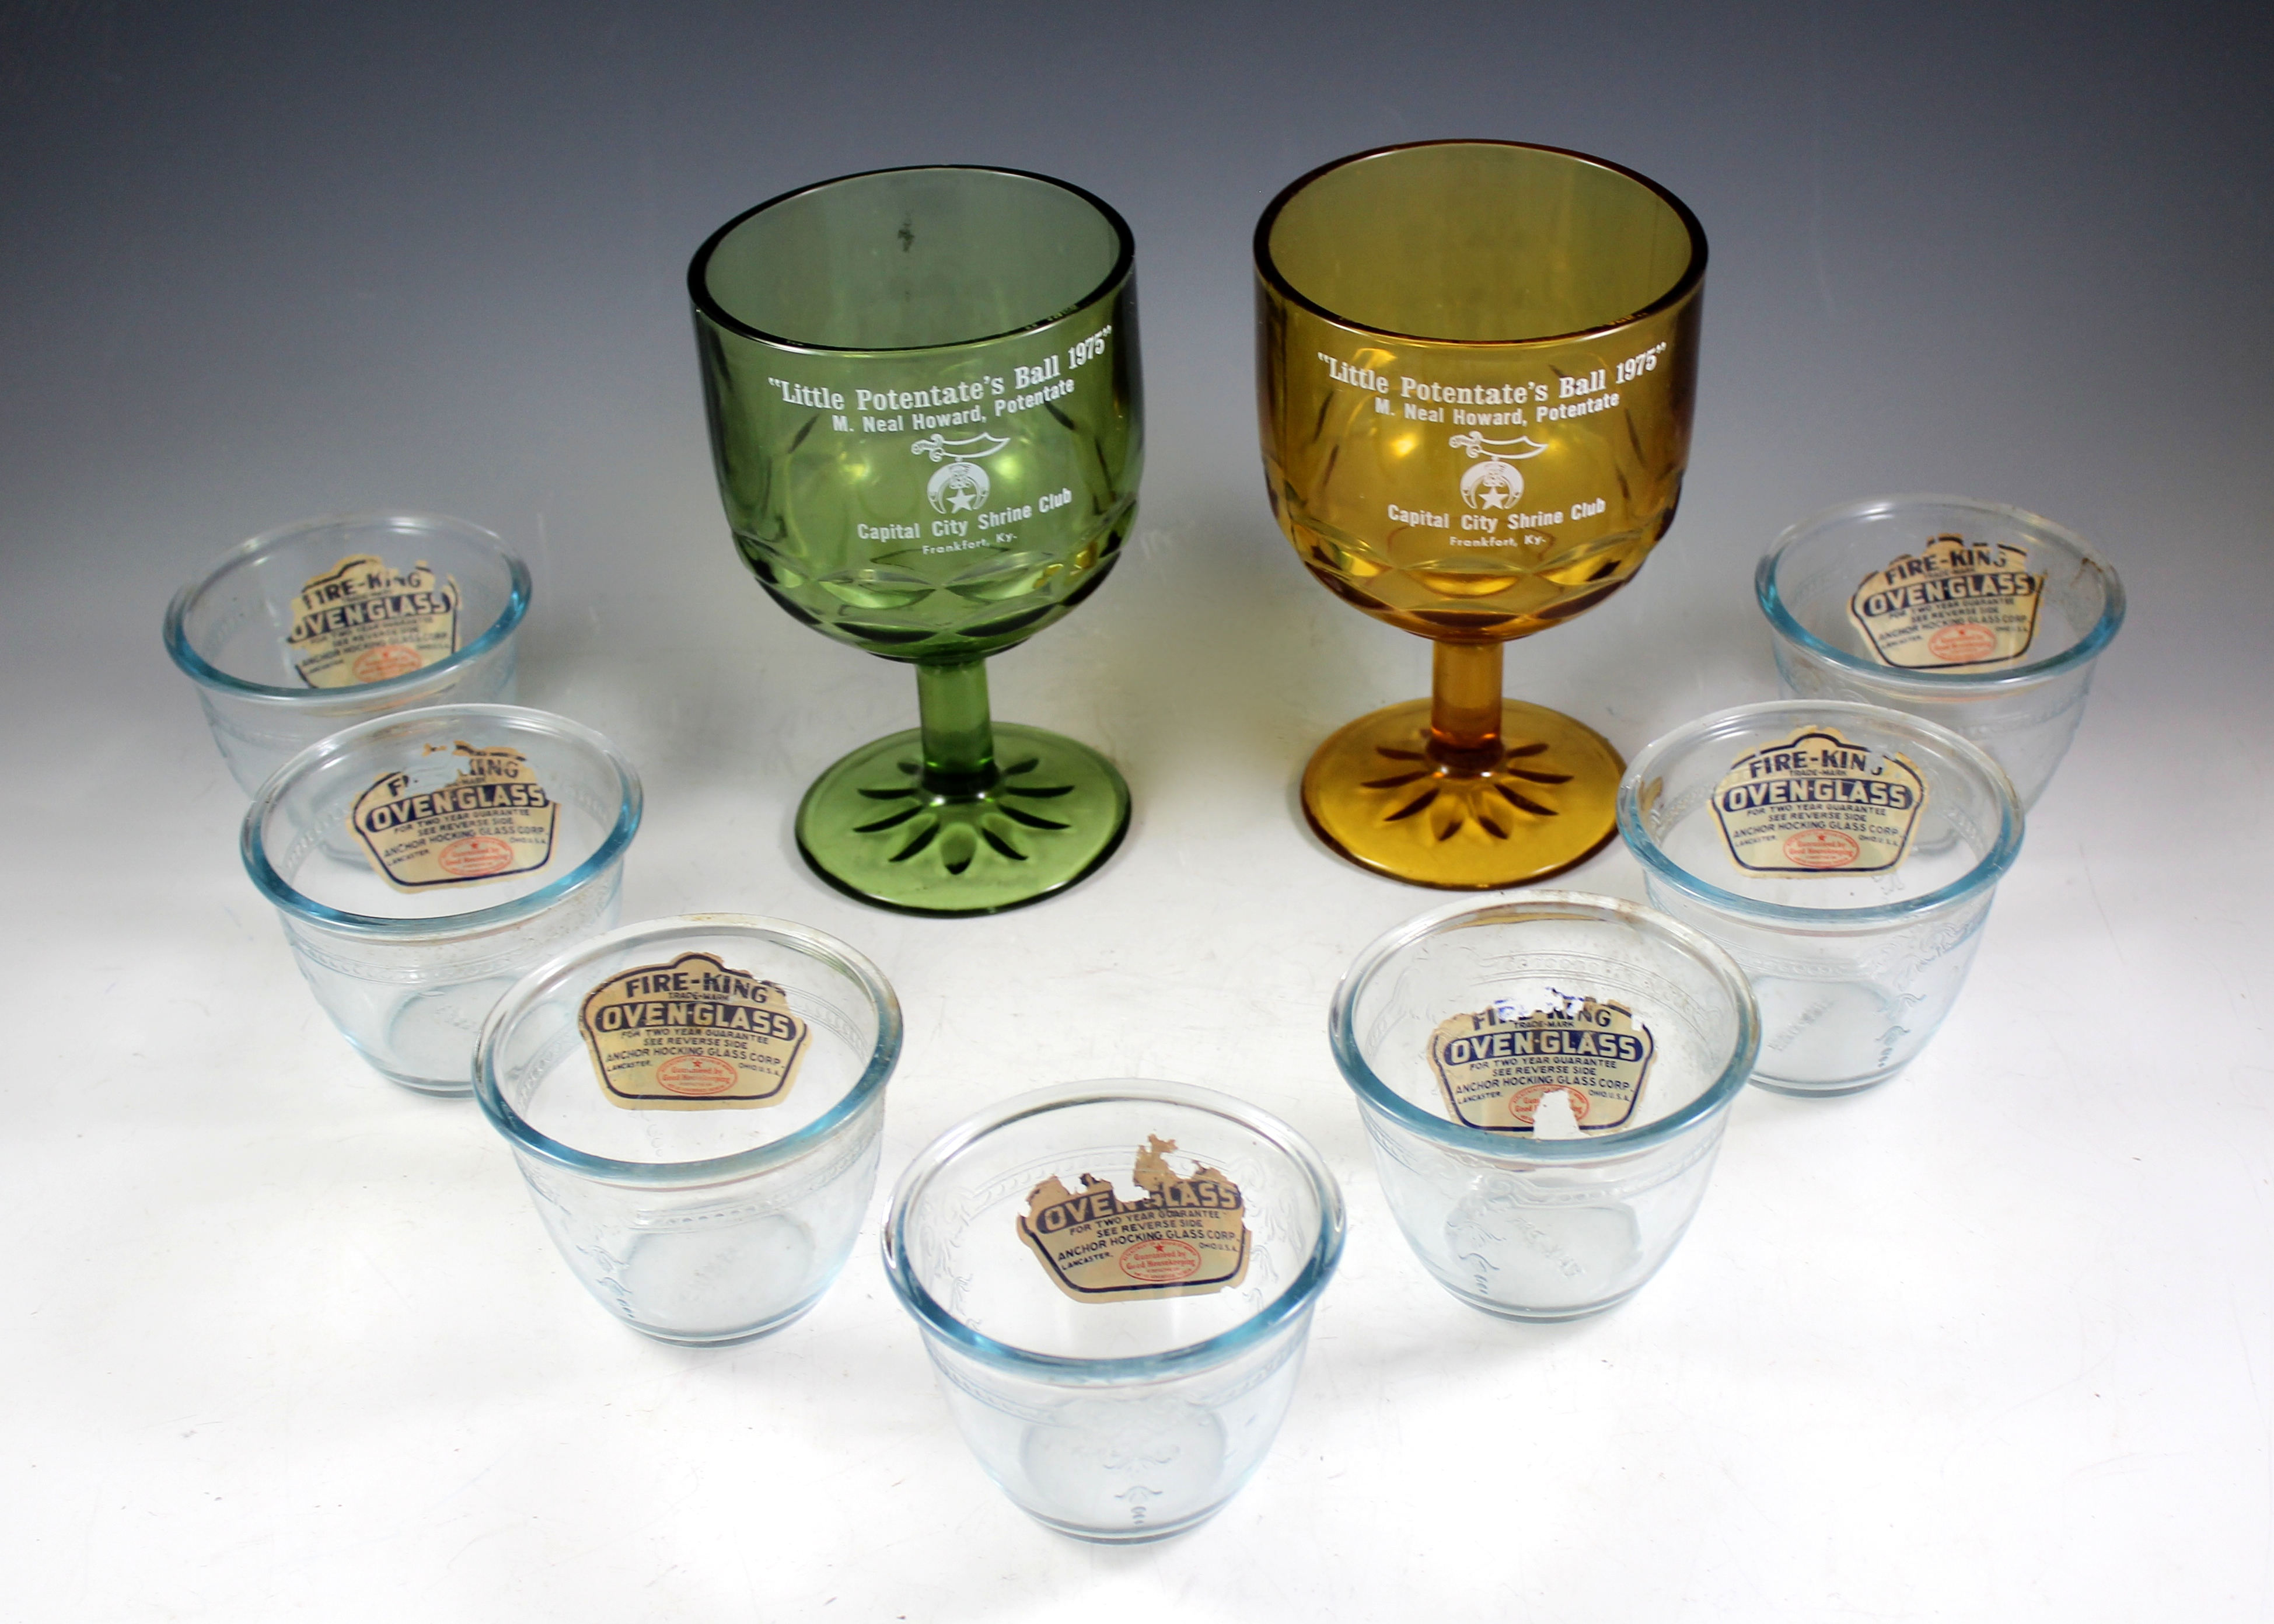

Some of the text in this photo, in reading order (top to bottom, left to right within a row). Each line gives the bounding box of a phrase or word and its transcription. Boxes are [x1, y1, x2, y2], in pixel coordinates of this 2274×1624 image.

[857, 375, 1005, 411] Potentate's
[1015, 354, 1060, 390] Ball
[1400, 376, 1547, 405] Potentate's
[1559, 369, 1606, 399] Ball
[832, 379, 1075, 432] M. Neal Howard, Potentate
[1375, 393, 1619, 427] M. Neal Howard, Potentate
[858, 488, 1072, 543] Capital City Shrine Club
[1388, 498, 1606, 533] Capital City Shrine Club
[626, 972, 769, 1003] FIRE-KING
[1473, 1002, 1611, 1031] FI-ING
[606, 1048, 649, 1063] ANCHOR
[708, 1048, 746, 1060] GLASS
[668, 1036, 721, 1046] REVERSE
[724, 1039, 748, 1049] SIDE
[1493, 1066, 1597, 1077] SEE REVERSE SIDE
[1494, 1059, 1518, 1067] TWO
[1553, 1056, 1617, 1068] GUARANTEE
[1455, 1079, 1500, 1094] ANCHOR
[1503, 1075, 1553, 1085] HOCKING
[1557, 1075, 1597, 1085] GLASS
[1045, 1181, 1237, 1232] OVEGLASS
[1097, 1217, 1122, 1228] TWO
[1125, 1211, 1155, 1222] YEAR
[1097, 1228, 1120, 1238] SEE
[1122, 1221, 1176, 1232] REVERSE
[1058, 1240, 1107, 1262] ANCHOR
[1110, 1231, 1163, 1246] HOCKING
[1165, 1230, 1204, 1239] GLASS
